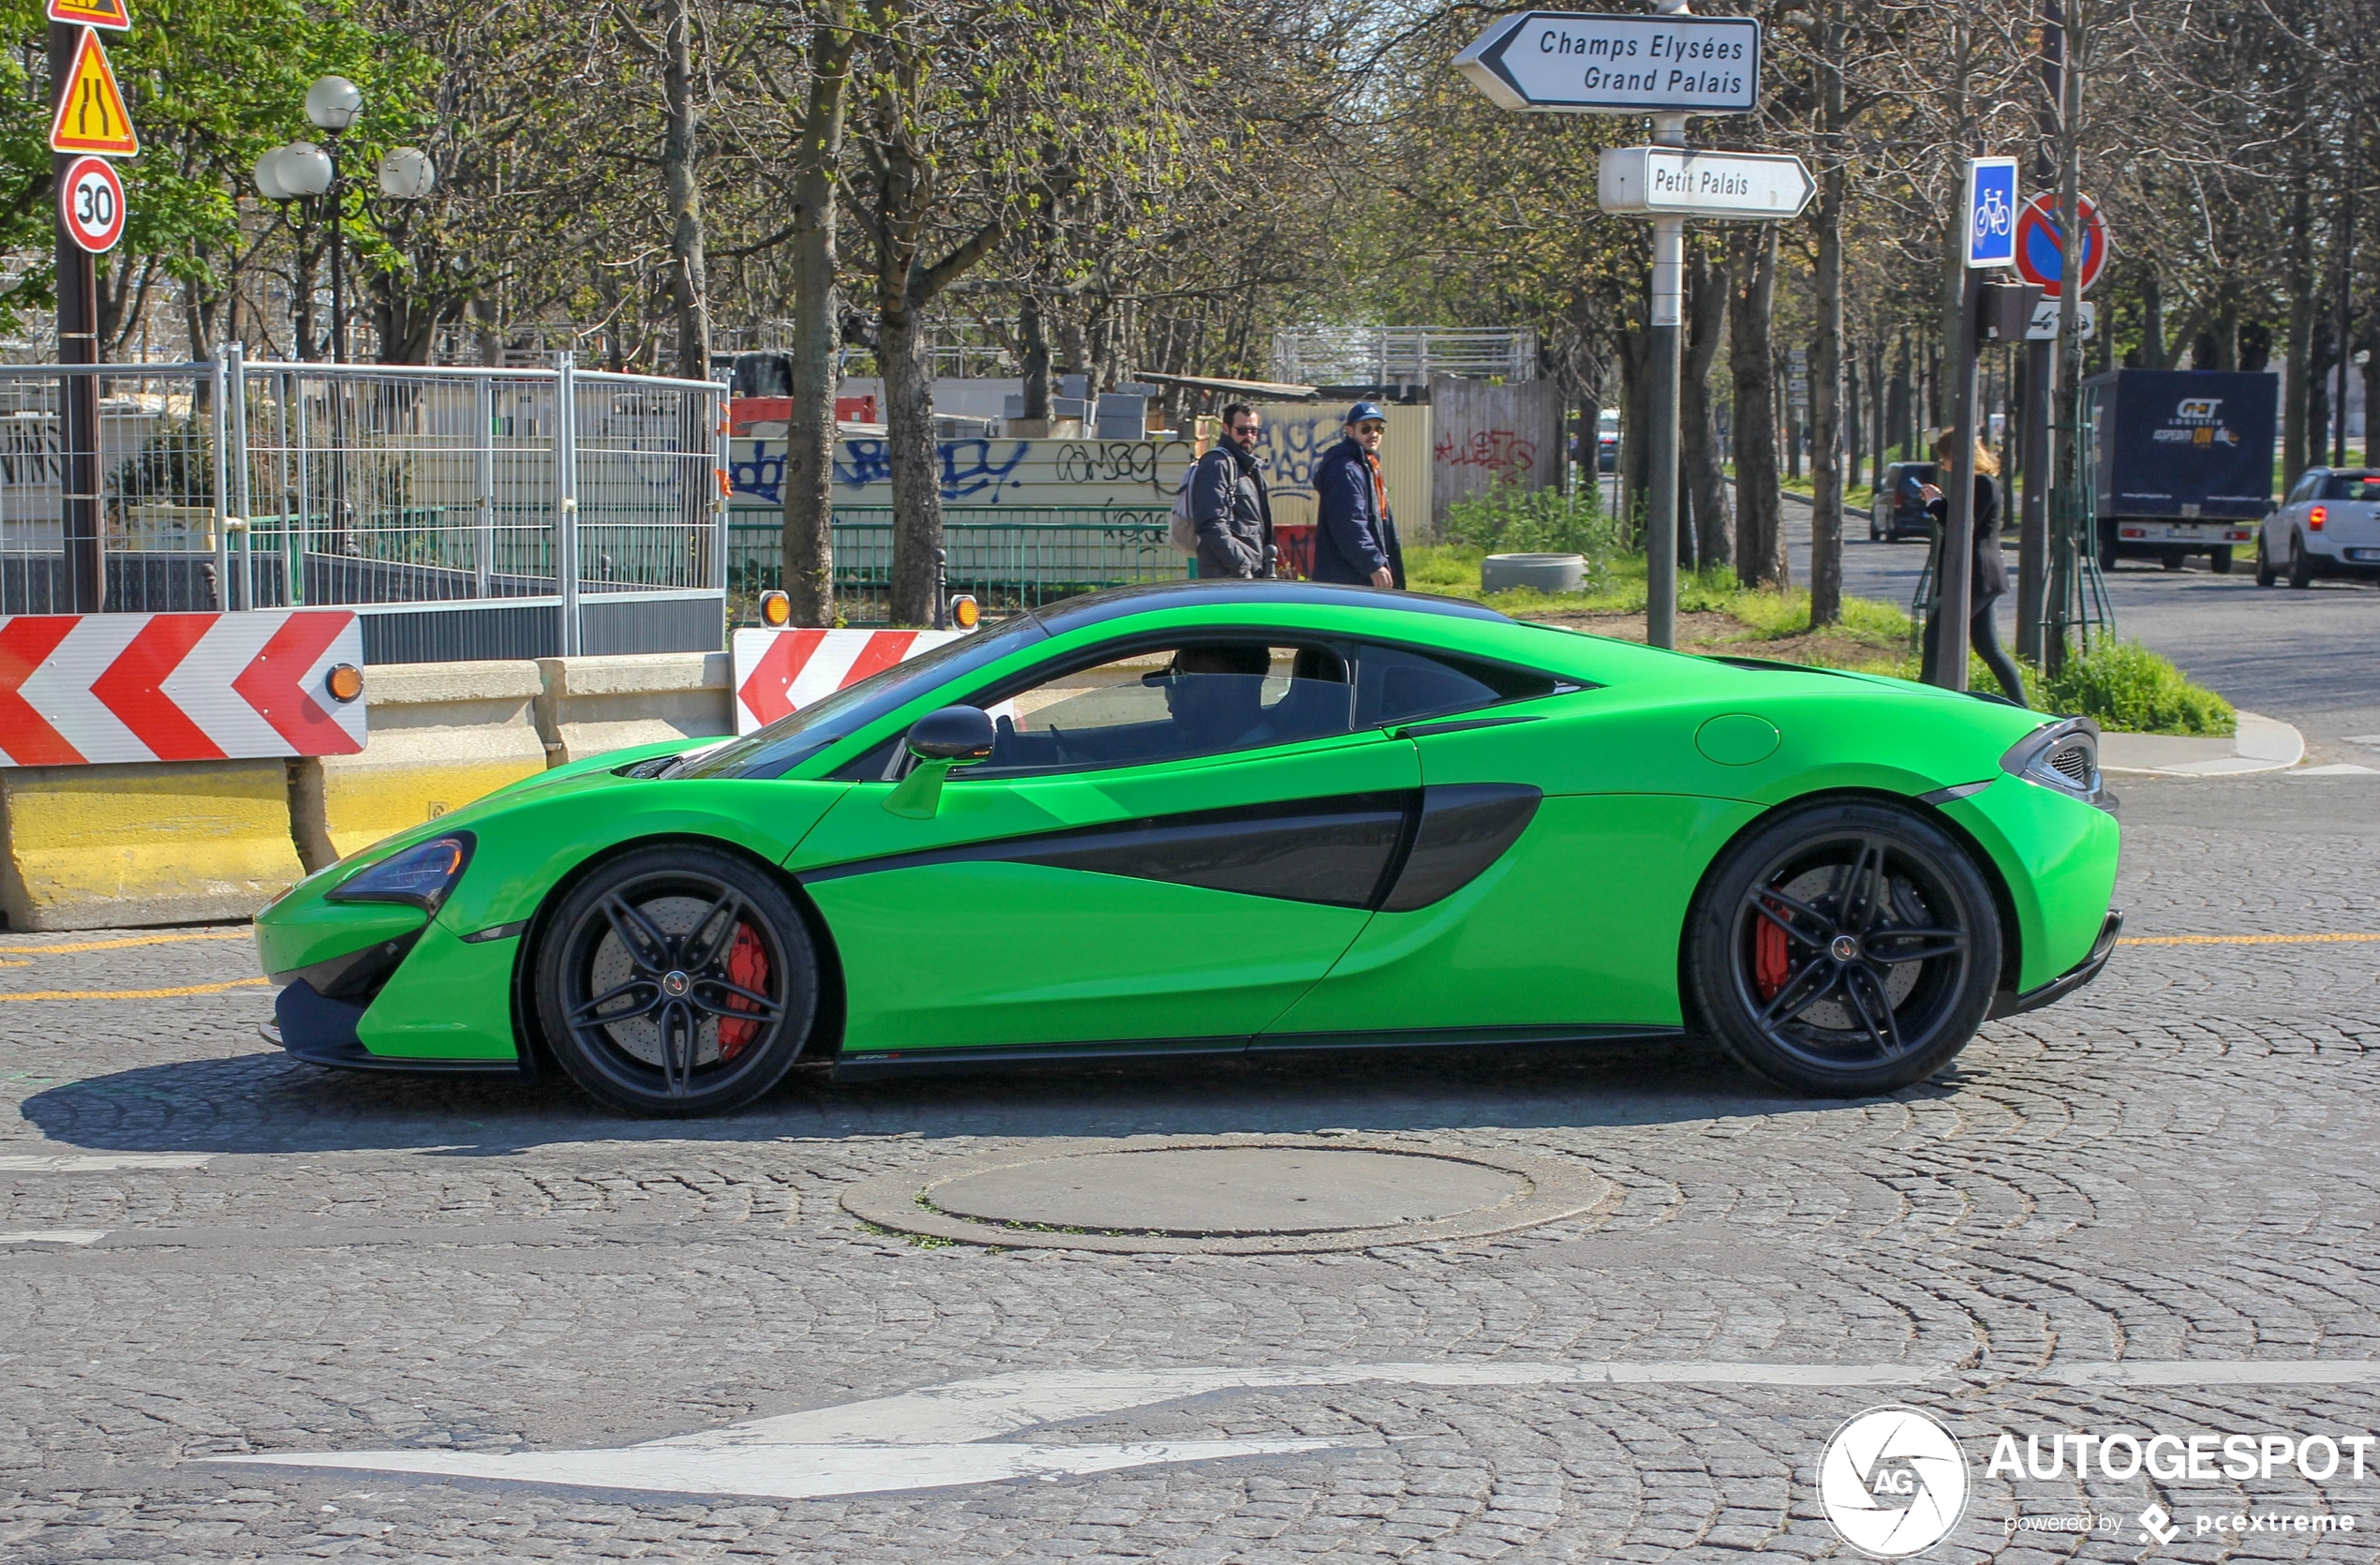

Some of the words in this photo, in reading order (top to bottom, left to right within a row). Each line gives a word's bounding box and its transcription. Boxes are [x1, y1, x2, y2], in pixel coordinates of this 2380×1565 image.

[1540, 30, 1638, 62] Champs
[1650, 35, 1743, 63] Elysées
[1584, 67, 1657, 92] Grand
[1667, 69, 1742, 94] Palais
[1655, 168, 1693, 193] Petit
[1701, 171, 1748, 196] Palais
[77, 183, 113, 225] 30
